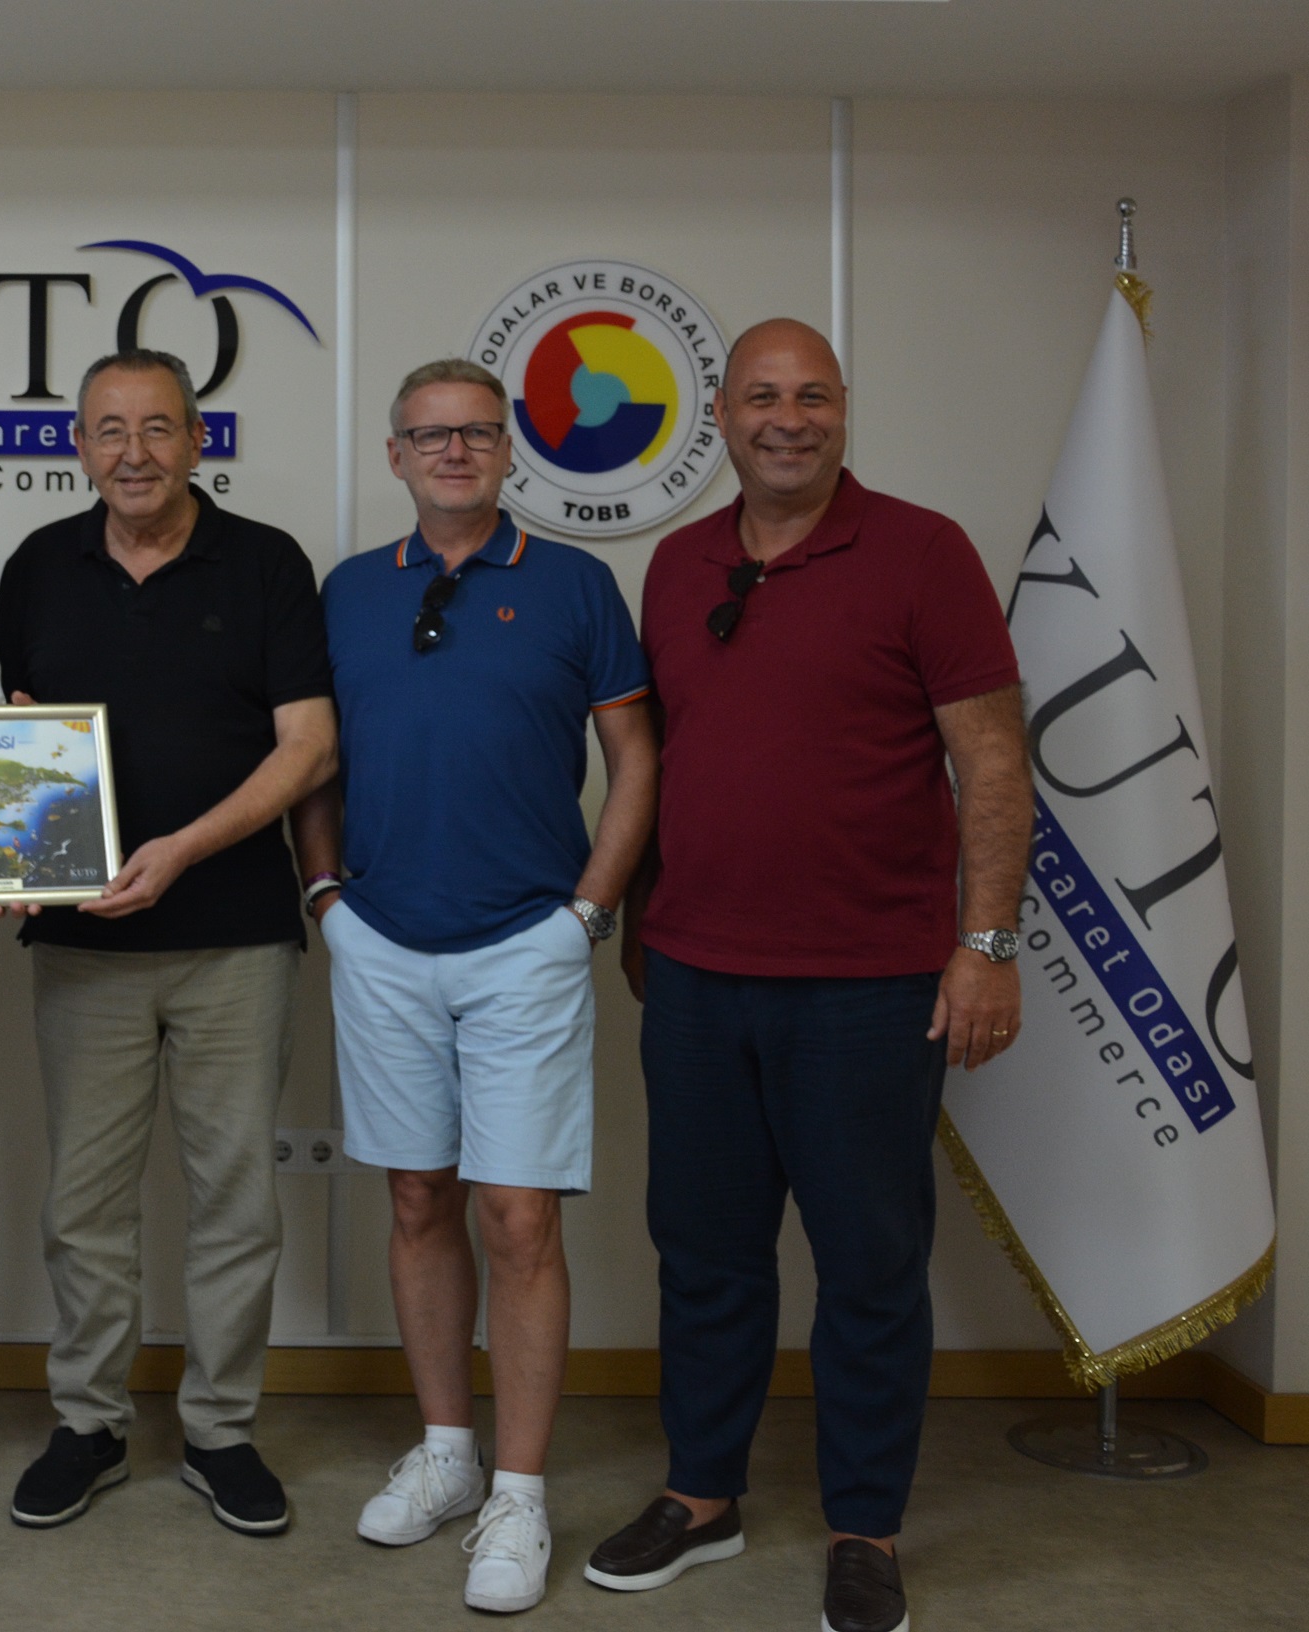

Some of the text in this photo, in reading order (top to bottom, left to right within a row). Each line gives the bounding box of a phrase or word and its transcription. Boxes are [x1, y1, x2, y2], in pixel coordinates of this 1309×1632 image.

[481, 281, 562, 366] ODALAR
[573, 273, 606, 290] VE
[620, 277, 720, 390] BORSALAR
[563, 501, 631, 522] TOBB
[1033, 807, 1221, 1122] icaret Odası
